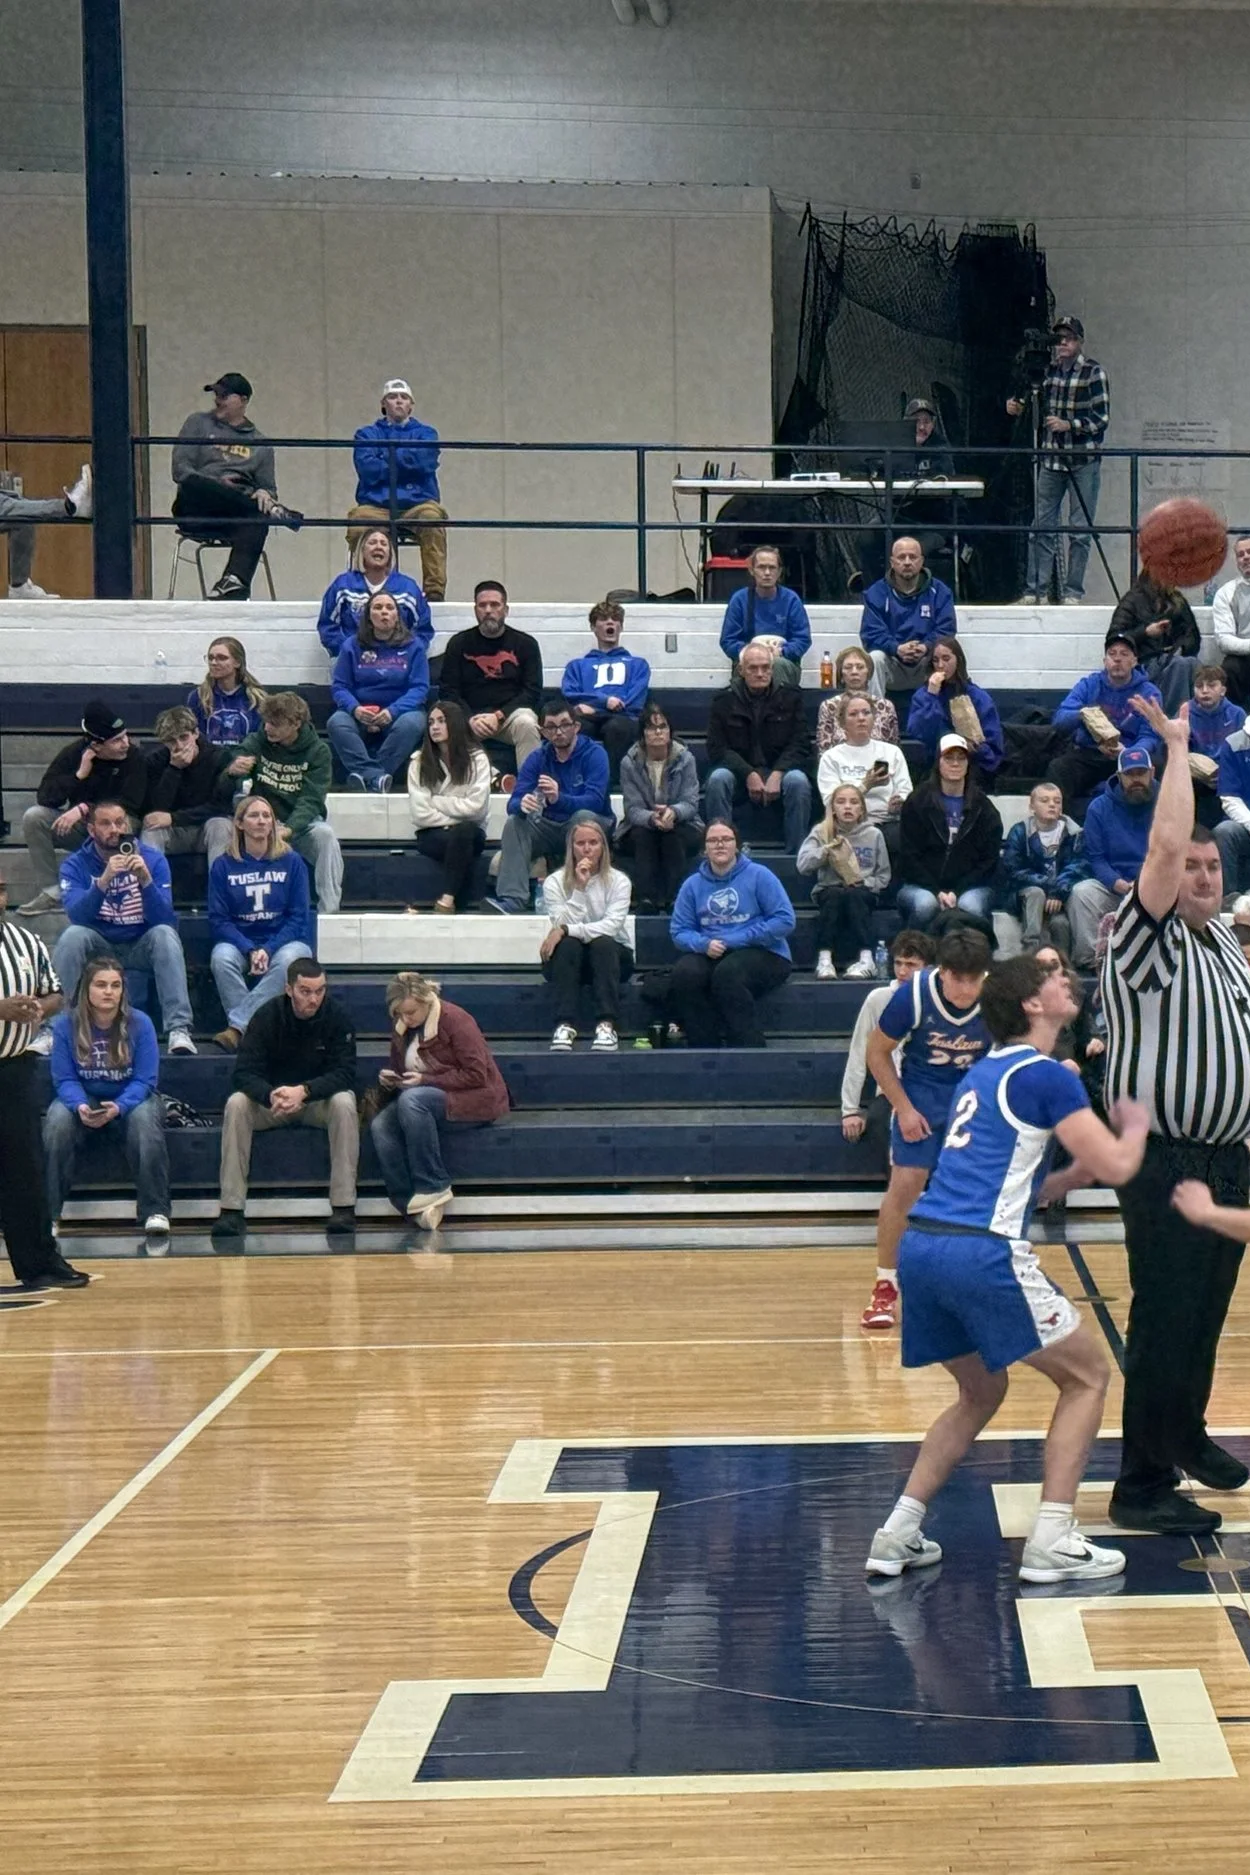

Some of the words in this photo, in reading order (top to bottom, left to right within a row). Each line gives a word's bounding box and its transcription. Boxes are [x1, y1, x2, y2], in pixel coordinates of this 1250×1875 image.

[592, 661, 626, 689] D
[227, 870, 287, 886] TUSLAW
[245, 882, 271, 912] T
[944, 1089, 978, 1149] 2
